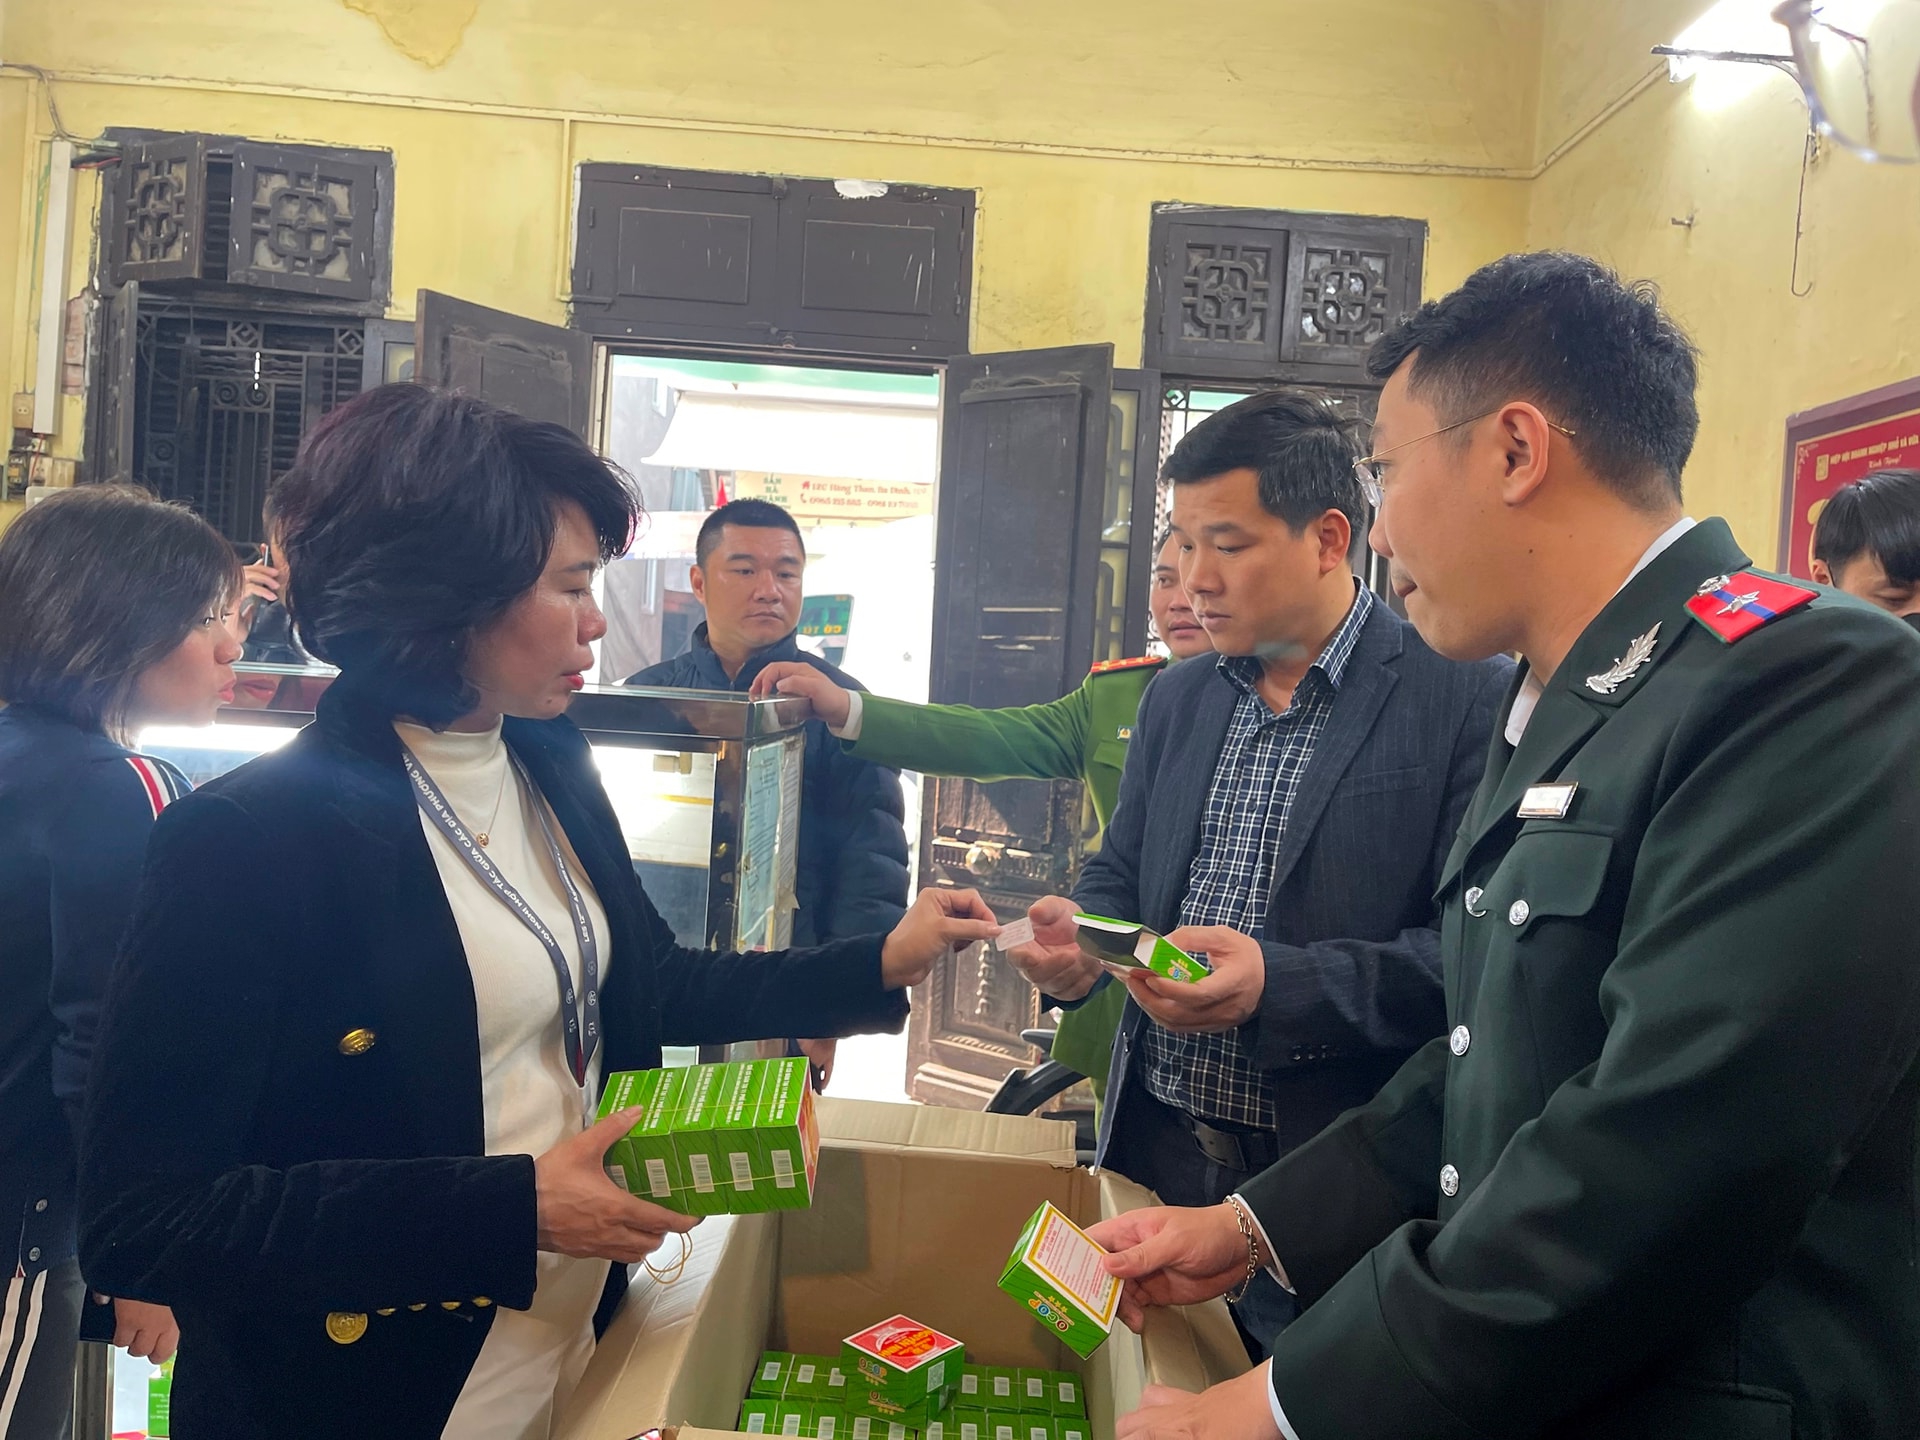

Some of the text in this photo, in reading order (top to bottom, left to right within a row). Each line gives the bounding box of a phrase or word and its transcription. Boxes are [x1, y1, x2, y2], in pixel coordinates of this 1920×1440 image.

[1851, 447, 1868, 460] DOANH
[410, 769, 444, 812] PHƯƠNG
[441, 810, 457, 829] ĐỊA
[454, 828, 472, 848] CÁC
[470, 847, 491, 871] GIỮA
[488, 870, 503, 891] TÁC
[503, 889, 523, 908] HỢP
[522, 906, 542, 931] NGHỊ
[540, 929, 555, 947] HỘI
[1028, 1298, 1069, 1332] OCOP
